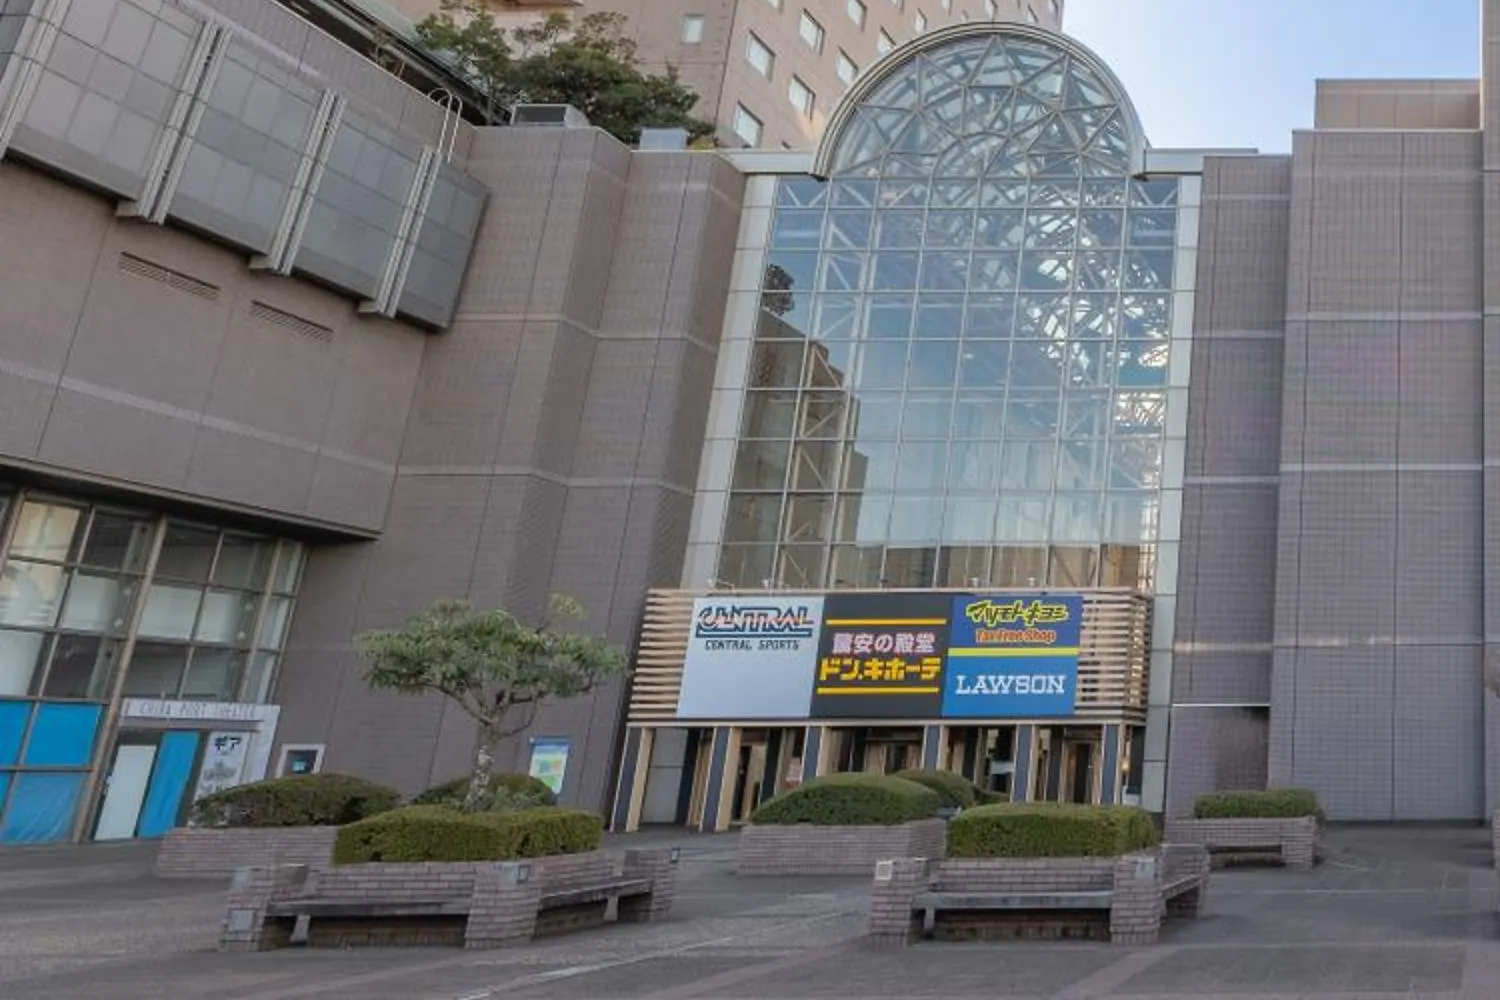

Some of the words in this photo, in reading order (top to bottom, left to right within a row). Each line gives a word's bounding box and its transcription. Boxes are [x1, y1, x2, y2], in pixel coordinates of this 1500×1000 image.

[696, 606, 814, 638] CENTRAL
[704, 640, 753, 651] CENTRAL
[955, 675, 1067, 695] LAWSON
